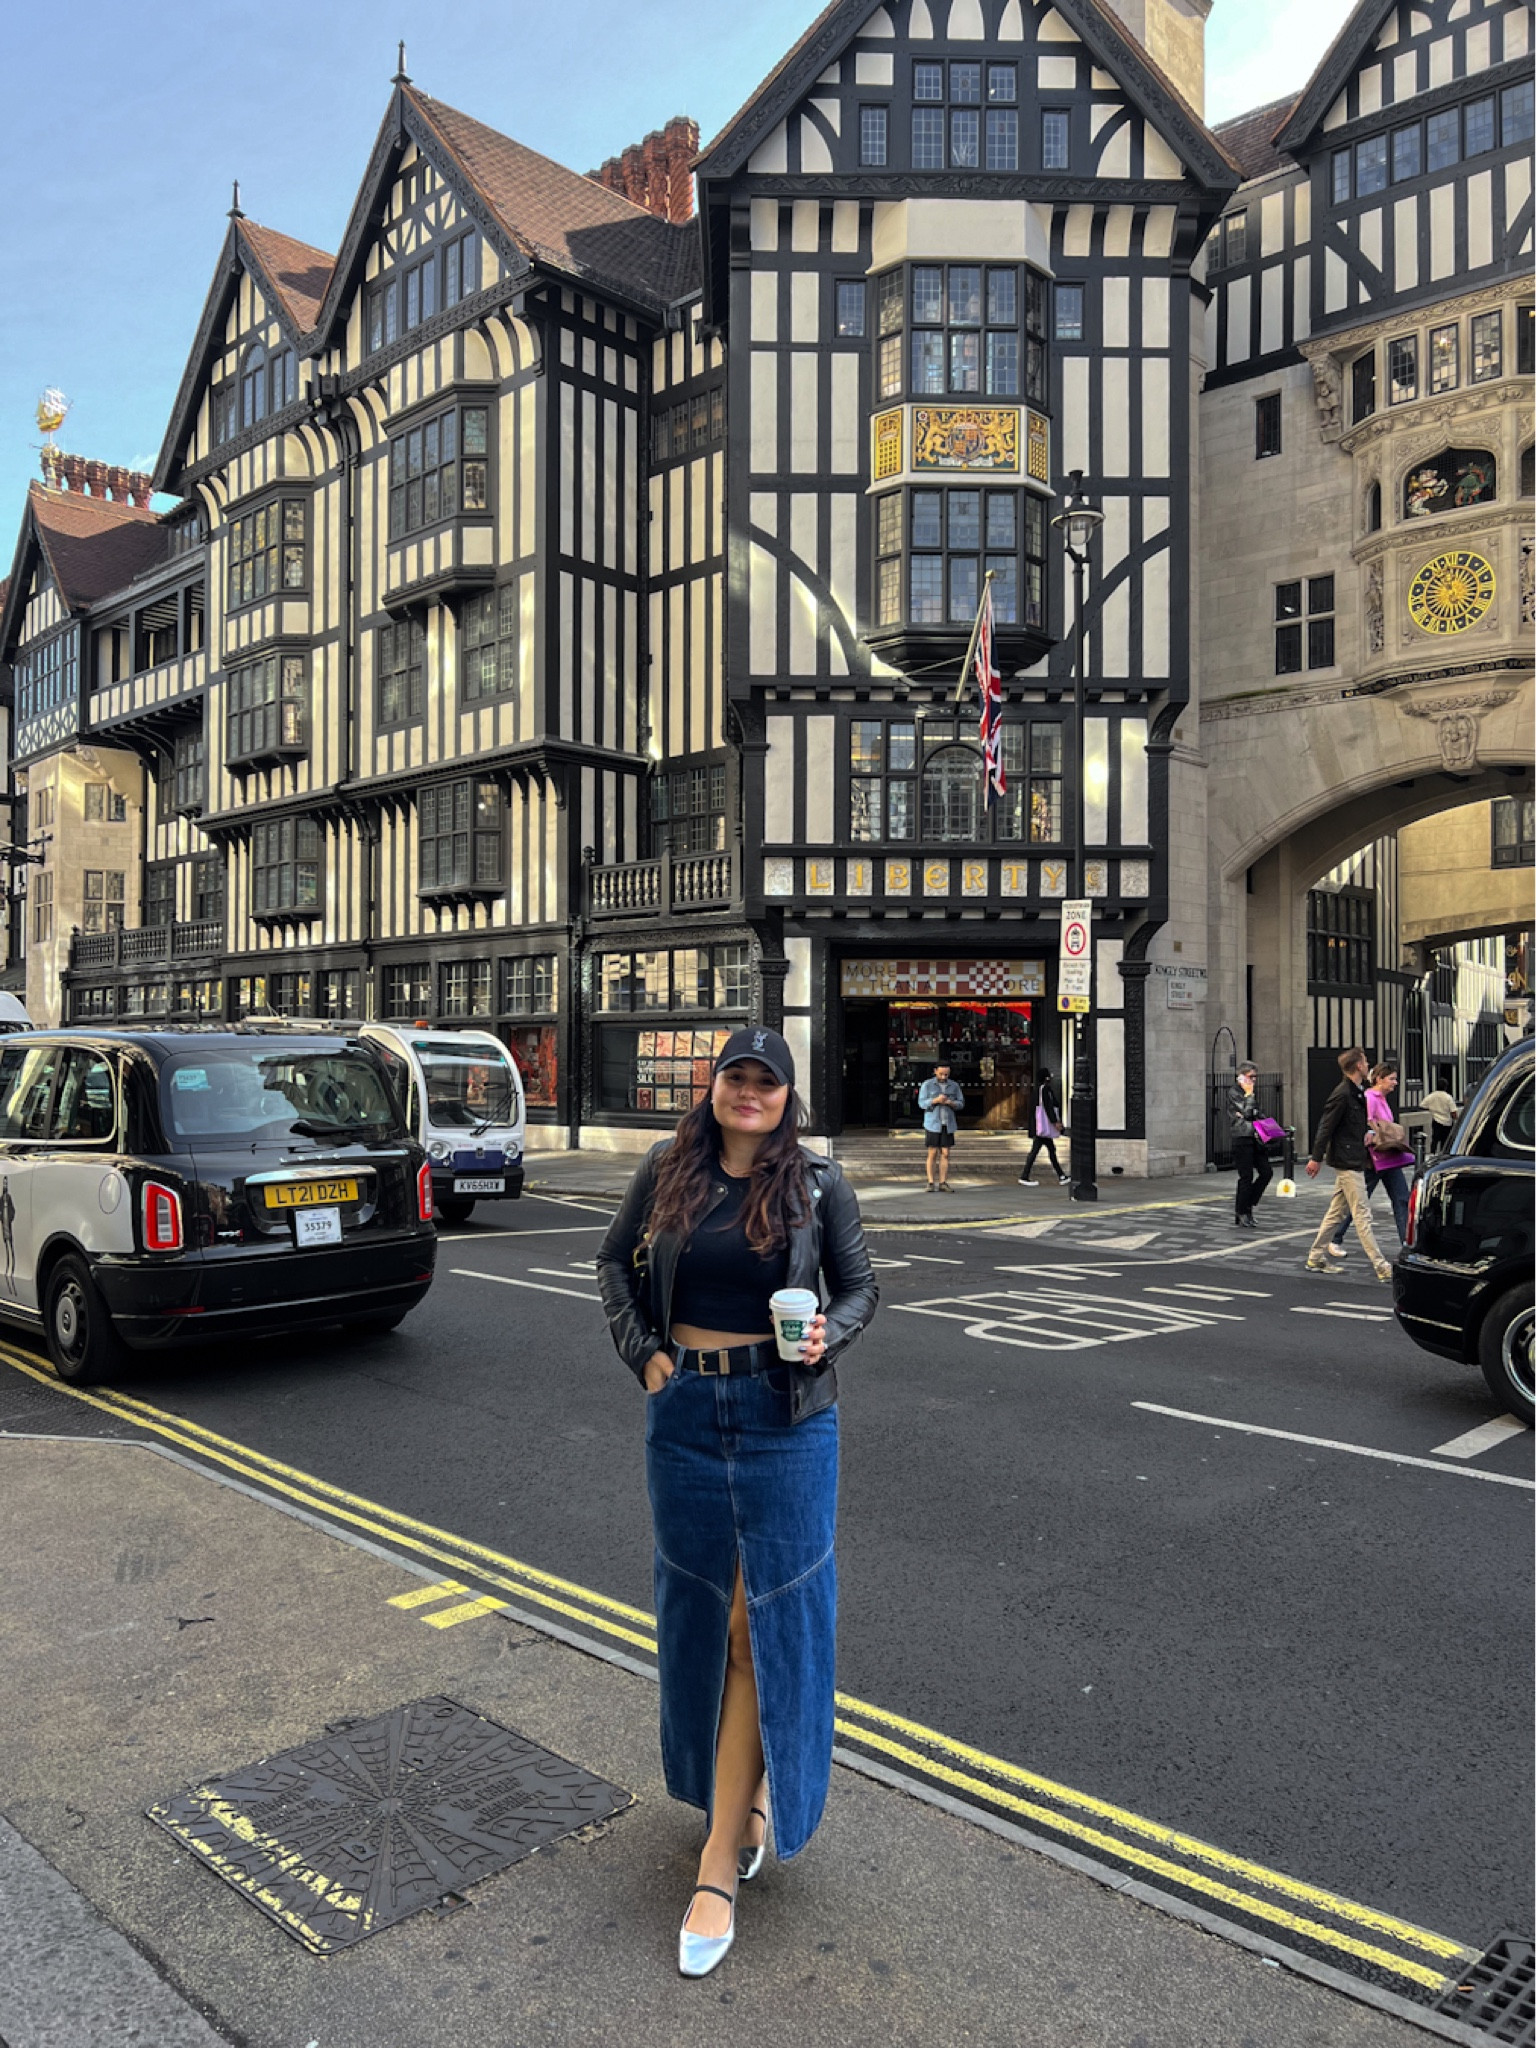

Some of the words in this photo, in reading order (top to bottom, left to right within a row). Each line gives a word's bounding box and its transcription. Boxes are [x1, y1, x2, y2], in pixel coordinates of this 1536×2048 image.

[810, 863, 1064, 890] LIBERTY
[1066, 911, 1087, 920] ZONE
[847, 965, 896, 977] MORE
[1155, 965, 1177, 976] KINGLY
[1178, 967, 1198, 978] STREET
[870, 979, 916, 991] THAN
[923, 979, 934, 991] A
[983, 979, 1041, 991] STORE
[276, 1186, 314, 1204] LT21
[317, 1182, 349, 1201] DZH
